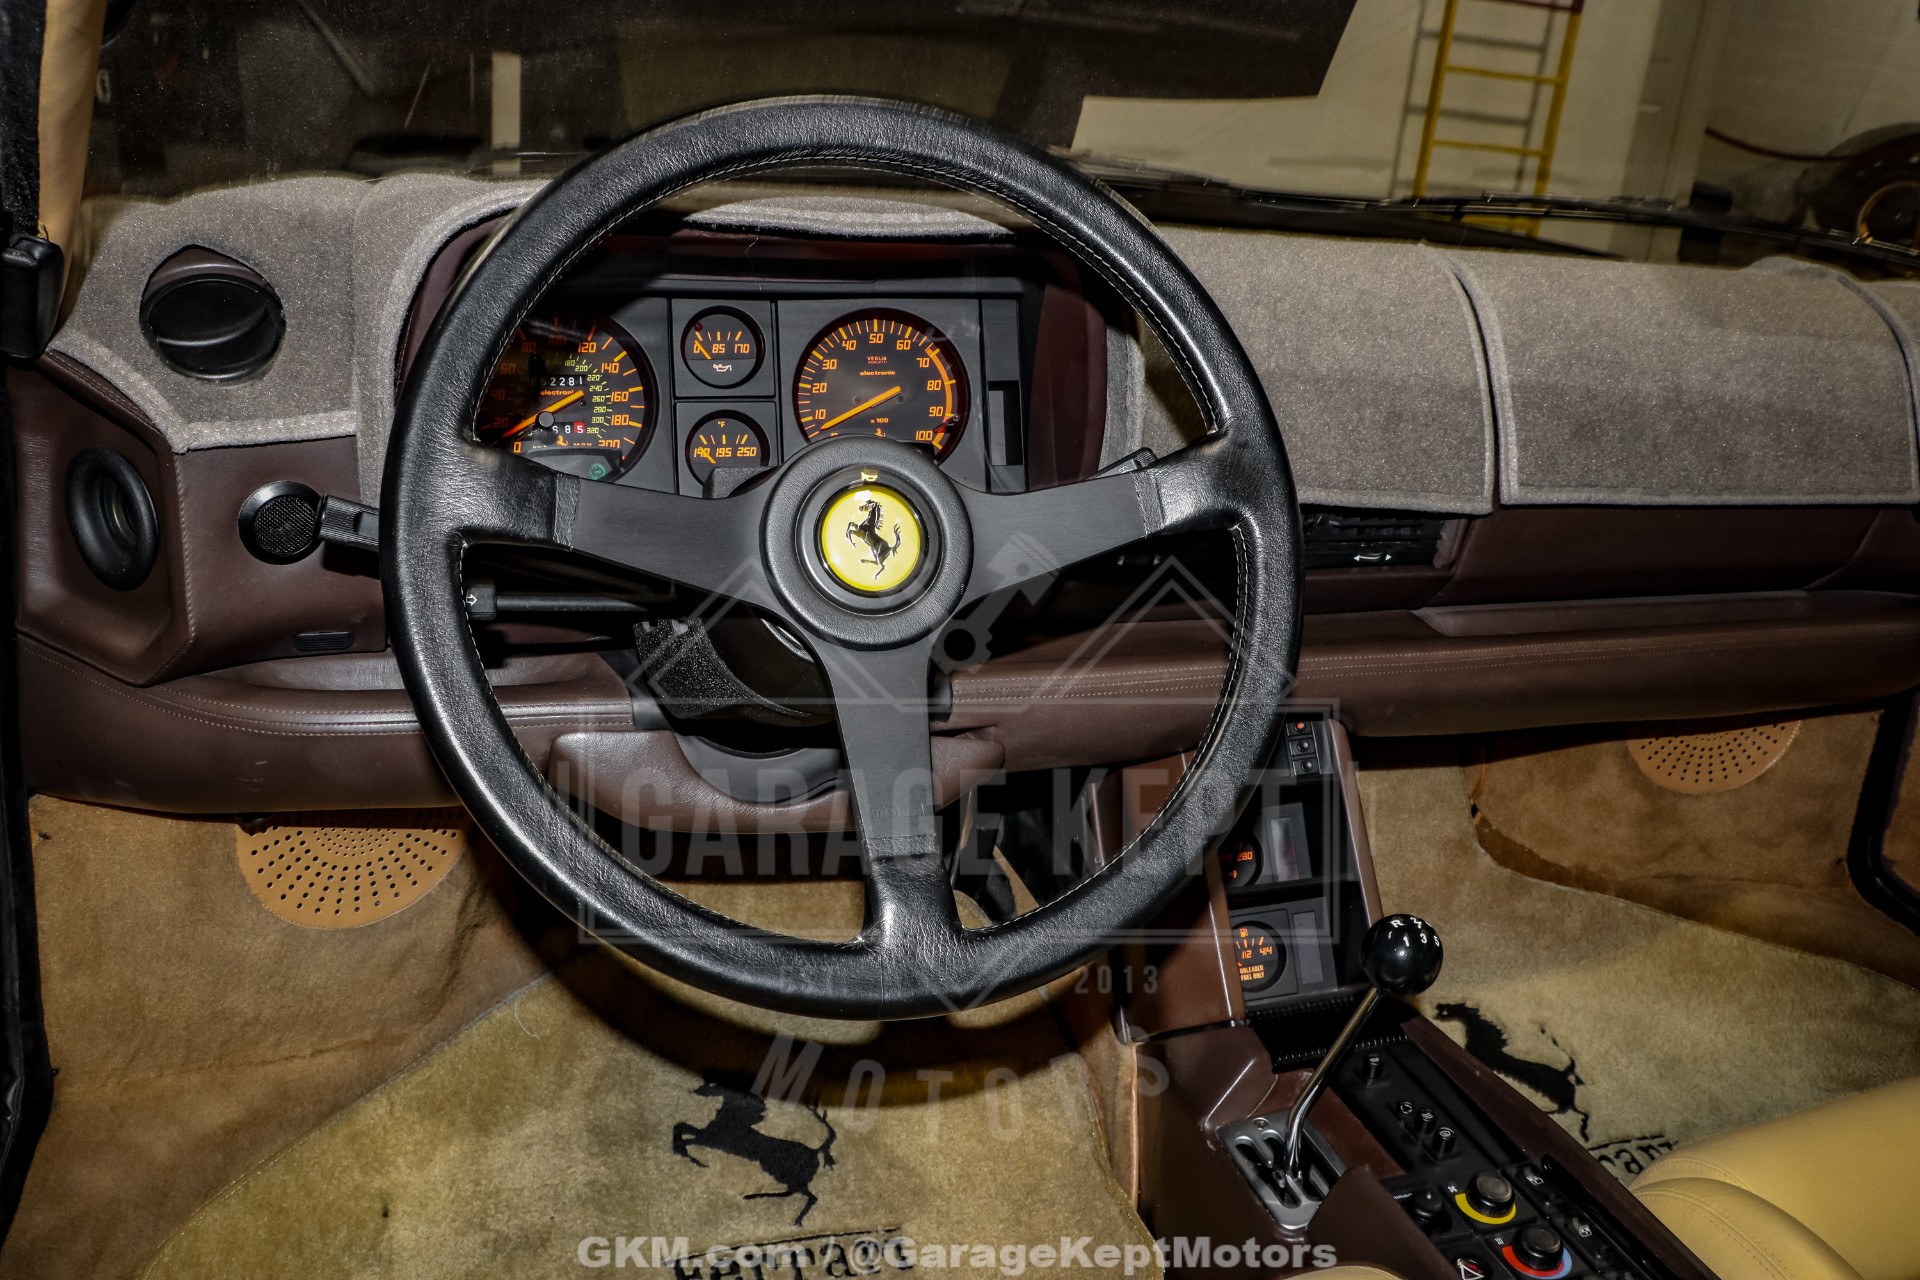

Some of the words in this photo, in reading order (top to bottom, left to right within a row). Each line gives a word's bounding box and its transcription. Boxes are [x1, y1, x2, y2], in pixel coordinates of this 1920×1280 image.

[869, 333, 884, 344] 50
[578, 342, 597, 353] 120
[711, 344, 726, 354] 85
[734, 344, 751, 354] 170
[842, 340, 857, 351] 40
[896, 340, 911, 351] 60
[601, 362, 619, 374] 140
[822, 359, 837, 370] 30
[916, 358, 930, 368] 70
[812, 383, 827, 393] 20
[927, 380, 942, 391] 80
[592, 395, 606, 403] 260
[610, 391, 629, 402] 160
[815, 409, 826, 420] 10
[929, 406, 944, 417] 90
[591, 416, 605, 424] 300
[610, 414, 629, 426] 180
[915, 430, 933, 441] 100
[513, 441, 523, 453] 0
[715, 447, 732, 458] 195
[736, 447, 757, 457] 250
[1237, 851, 1253, 861] 280
[1391, 919, 1405, 928] R
[1403, 935, 1410, 947] 1
[1420, 933, 1427, 944] 3
[1239, 965, 1264, 974] UNLEADED
[1240, 973, 1253, 981] FUEL
[1252, 971, 1265, 980] ONLY
